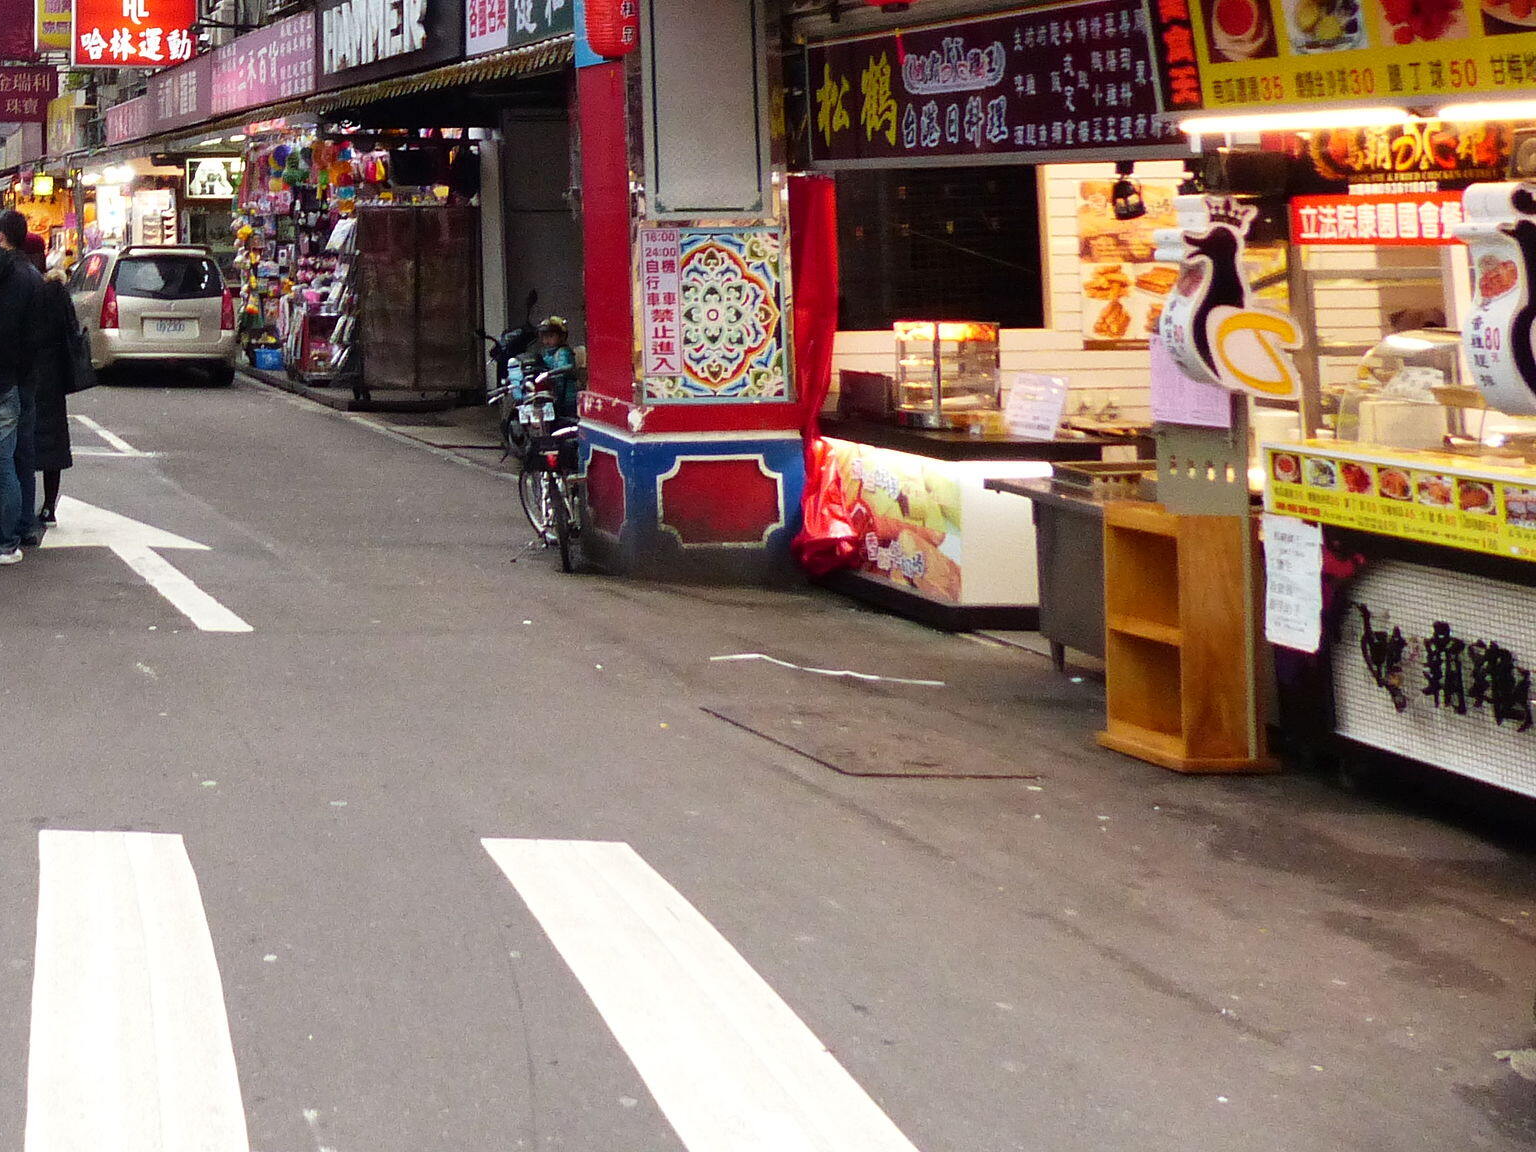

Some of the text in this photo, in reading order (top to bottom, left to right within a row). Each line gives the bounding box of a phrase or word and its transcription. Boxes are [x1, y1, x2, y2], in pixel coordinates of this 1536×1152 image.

[80, 27, 192, 62] 哈林運動
[1449, 58, 1477, 87] 50
[816, 50, 898, 147] 松鶴
[644, 246, 676, 258] 24:00
[651, 308, 676, 372] 禁止進入
